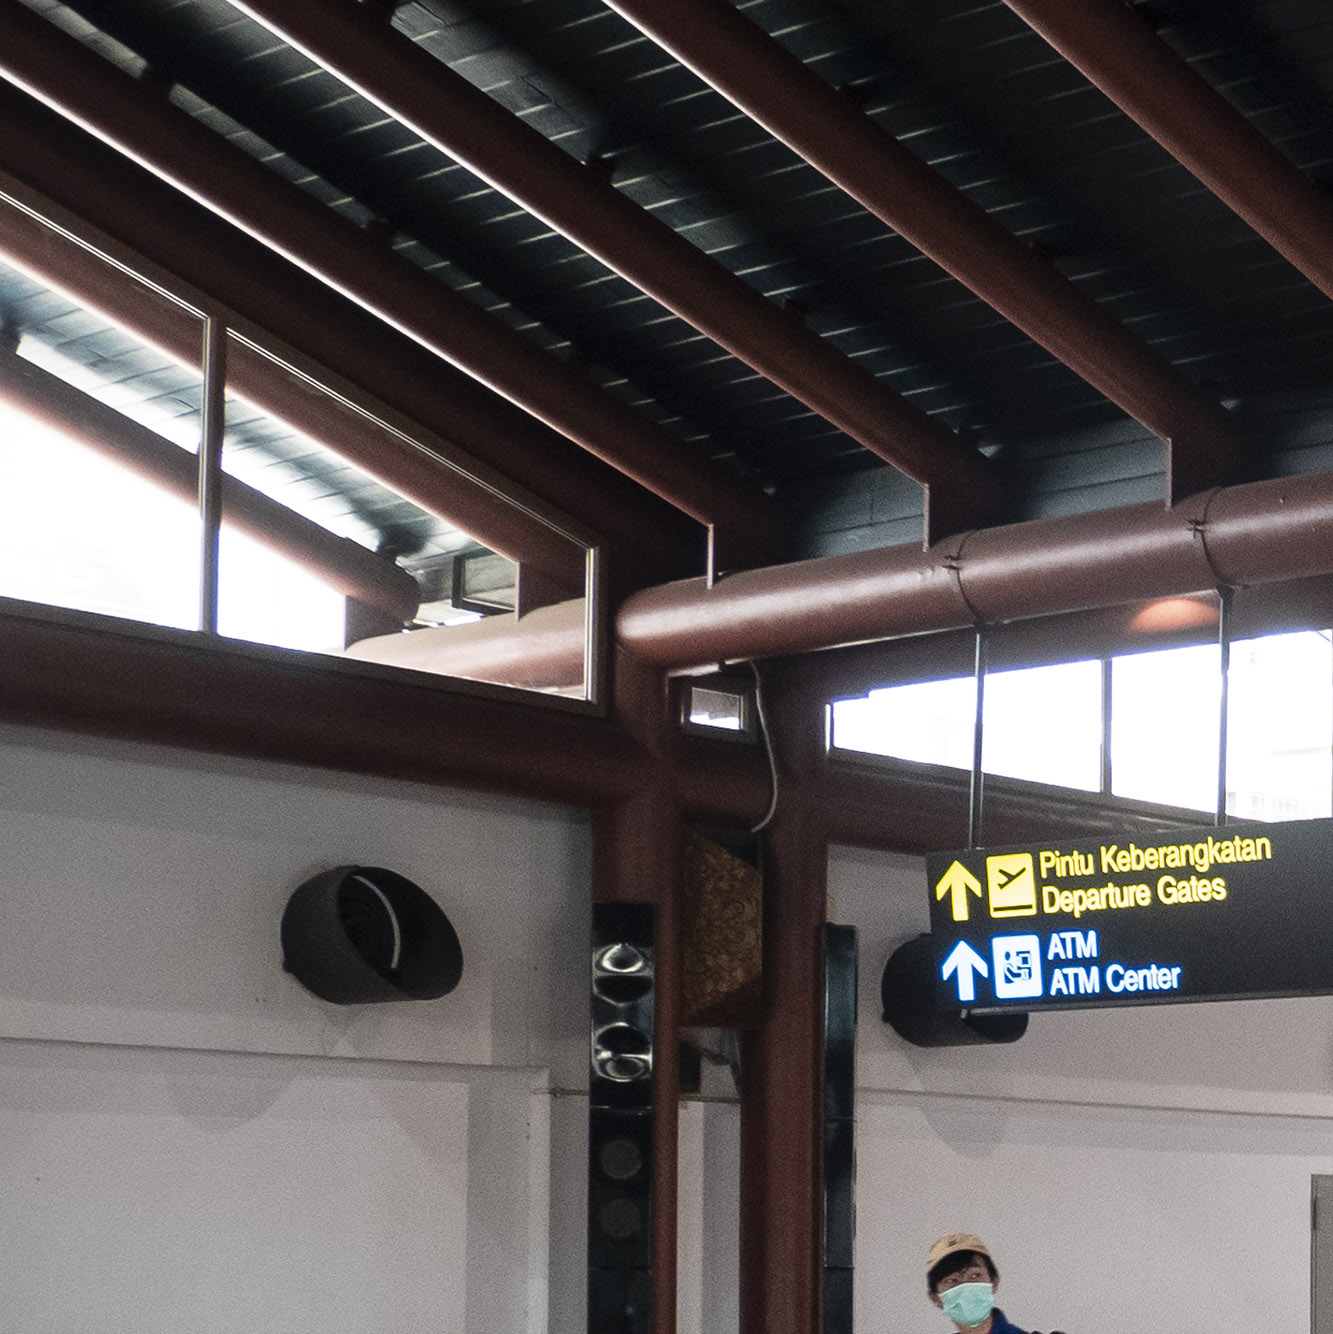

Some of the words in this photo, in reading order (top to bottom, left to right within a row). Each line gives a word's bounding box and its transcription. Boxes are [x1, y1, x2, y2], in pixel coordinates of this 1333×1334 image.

[1040, 848, 1095, 880] Pintu
[1101, 835, 1272, 875] Keberangkatan
[1042, 880, 1151, 918] Departure
[1157, 875, 1227, 905] Gates
[1046, 930, 1099, 961] ATM
[1049, 965, 1101, 996] ATM
[1104, 962, 1182, 994] Center
